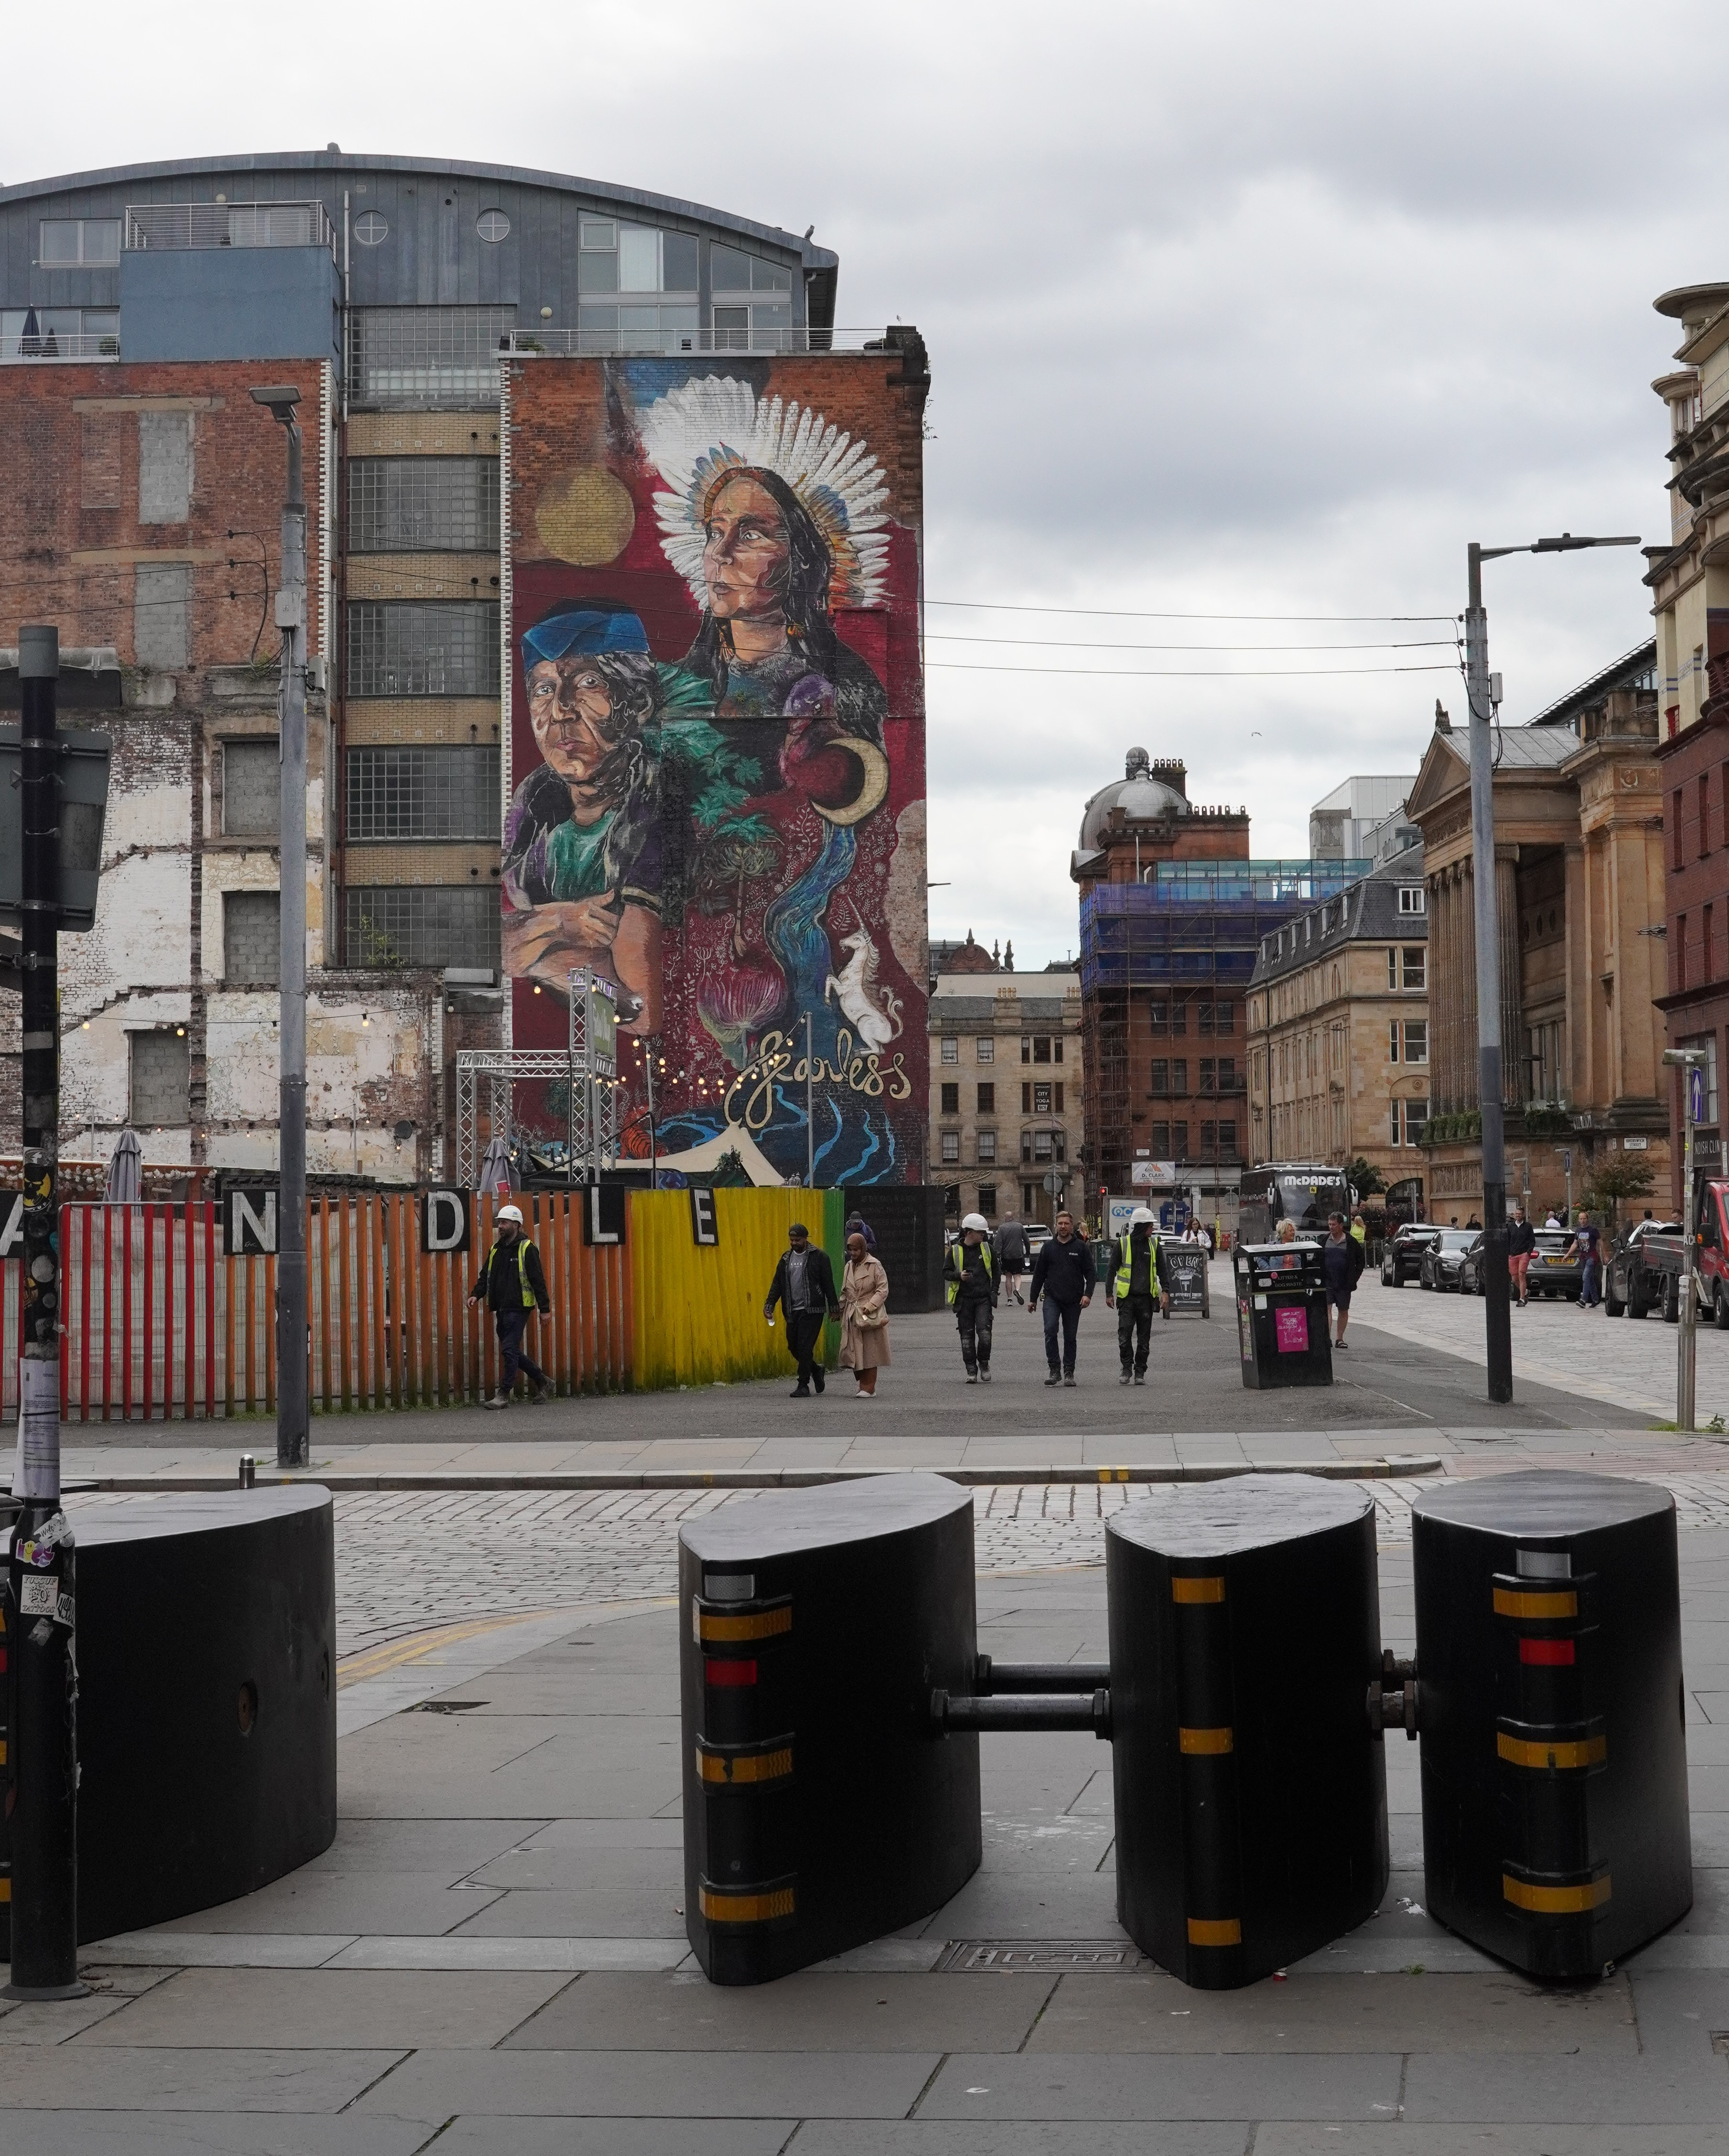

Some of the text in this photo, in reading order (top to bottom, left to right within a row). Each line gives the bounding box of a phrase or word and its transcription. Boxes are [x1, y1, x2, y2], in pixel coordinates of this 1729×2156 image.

[1284, 1176, 1341, 1186] McDADE'S
[1170, 1255, 1199, 1268] OPEN
[1181, 1281, 1190, 1291] T
[24, 1576, 57, 1585] YUSSUF
